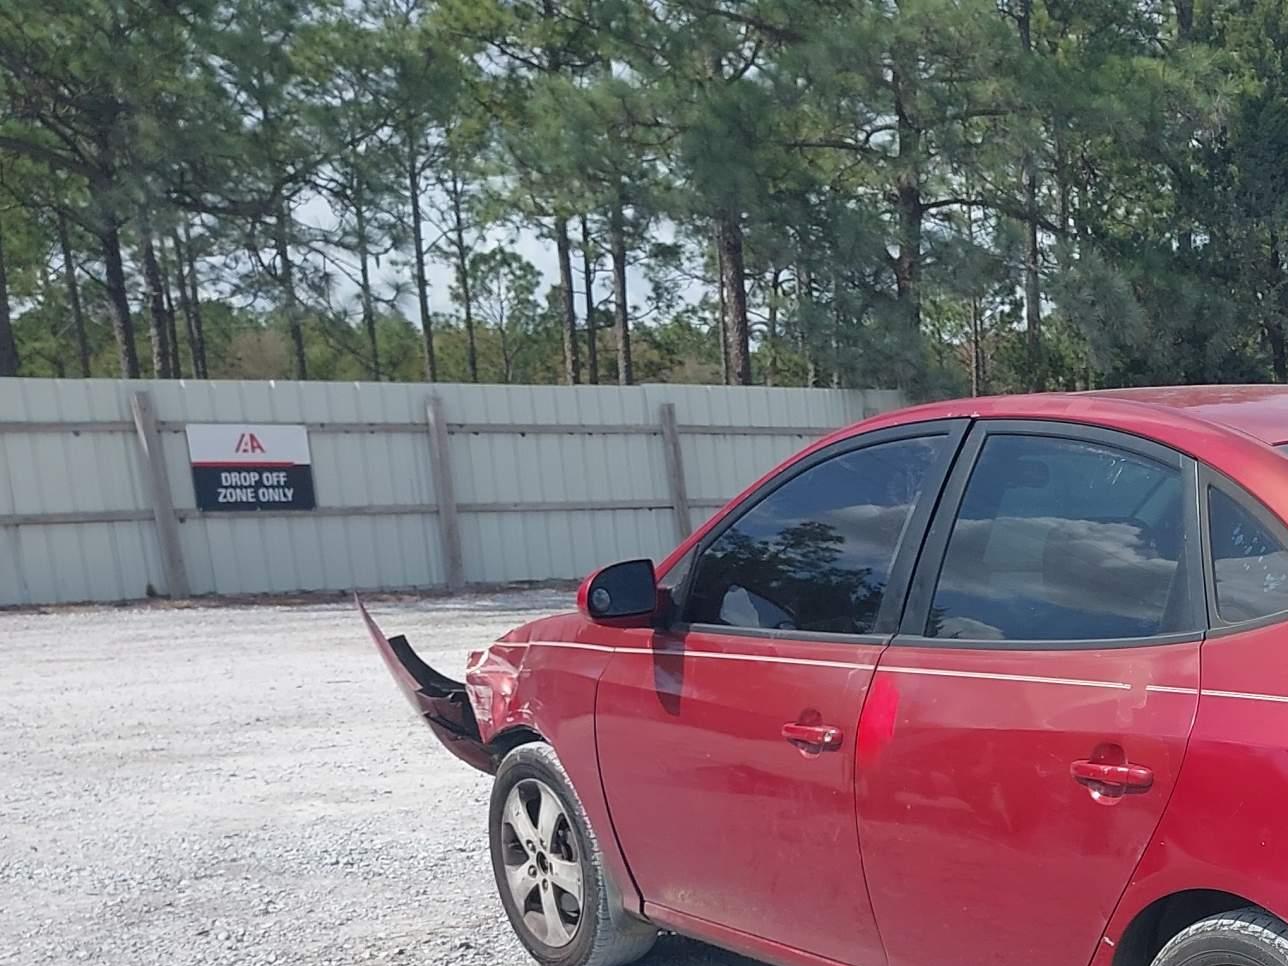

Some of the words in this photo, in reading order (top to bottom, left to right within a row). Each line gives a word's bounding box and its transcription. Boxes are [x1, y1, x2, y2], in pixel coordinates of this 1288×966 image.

[221, 472, 259, 486] DROP
[262, 472, 287, 486] OFF
[217, 488, 256, 502] ZONE
[258, 488, 293, 502] ONLY
